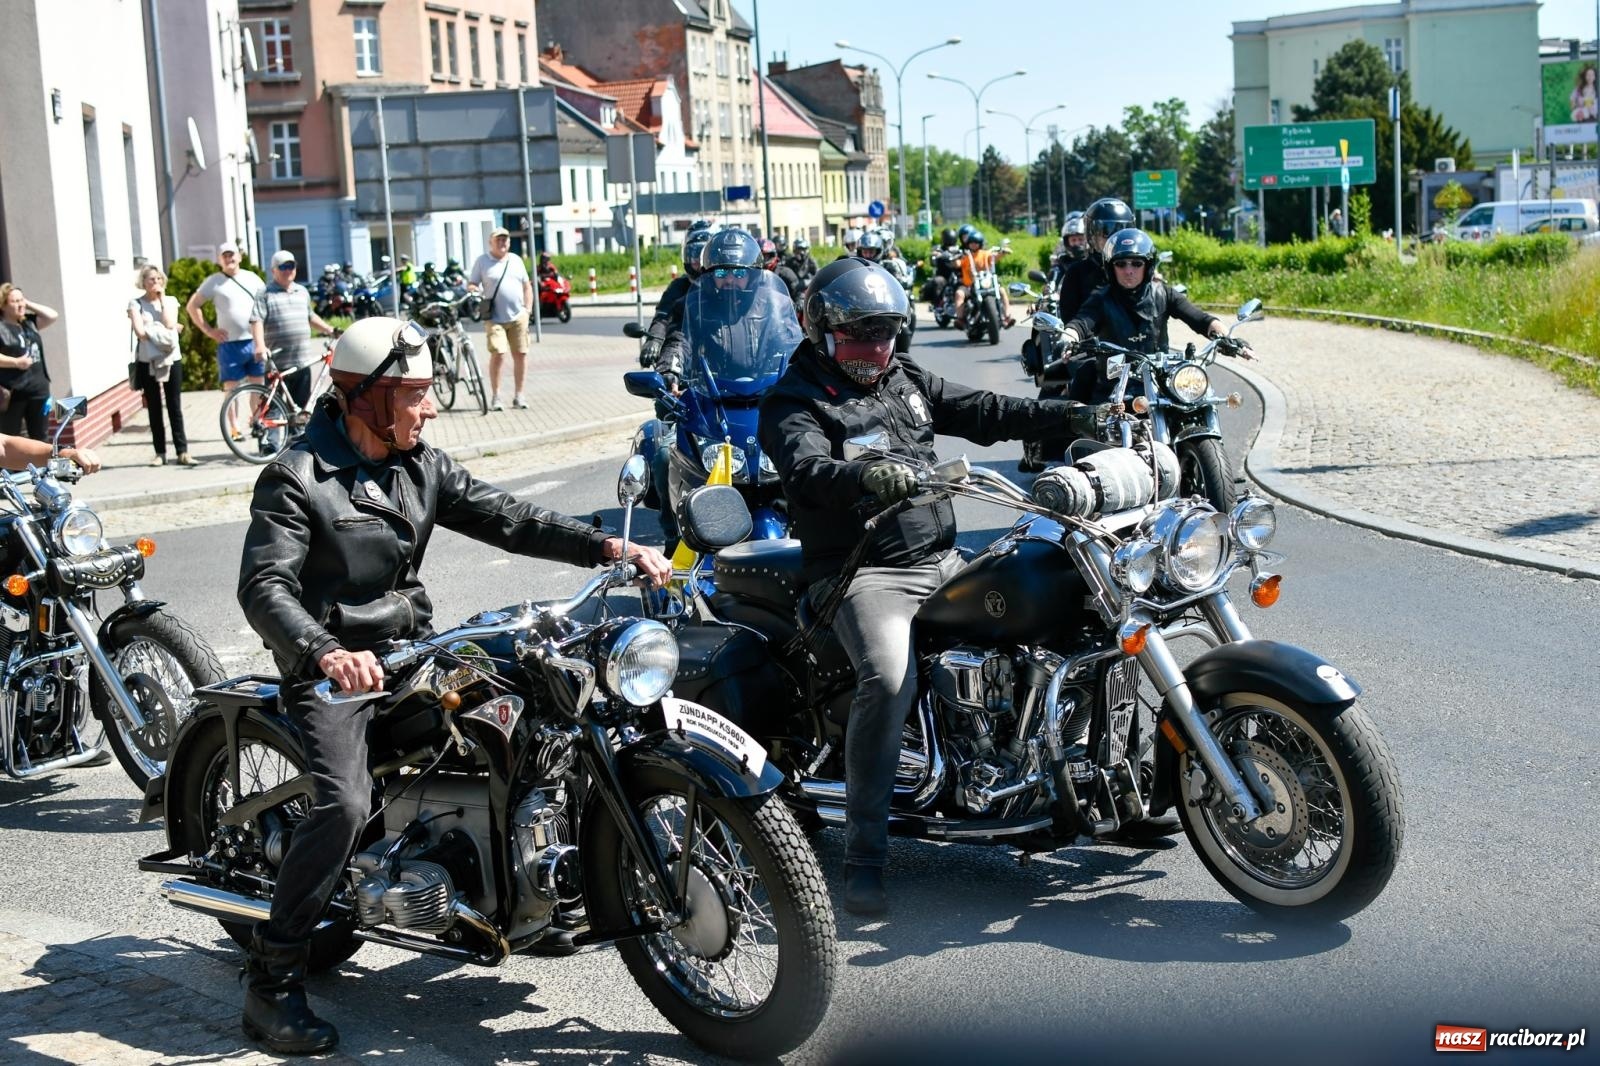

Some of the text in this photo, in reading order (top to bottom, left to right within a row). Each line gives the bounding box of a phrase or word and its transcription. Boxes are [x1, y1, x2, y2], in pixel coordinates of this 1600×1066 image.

[1282, 127, 1312, 136] Rybnik
[1282, 138, 1315, 146] Gliwice
[1283, 174, 1310, 184] Opole
[679, 704, 718, 725] ZÜNDAPP
